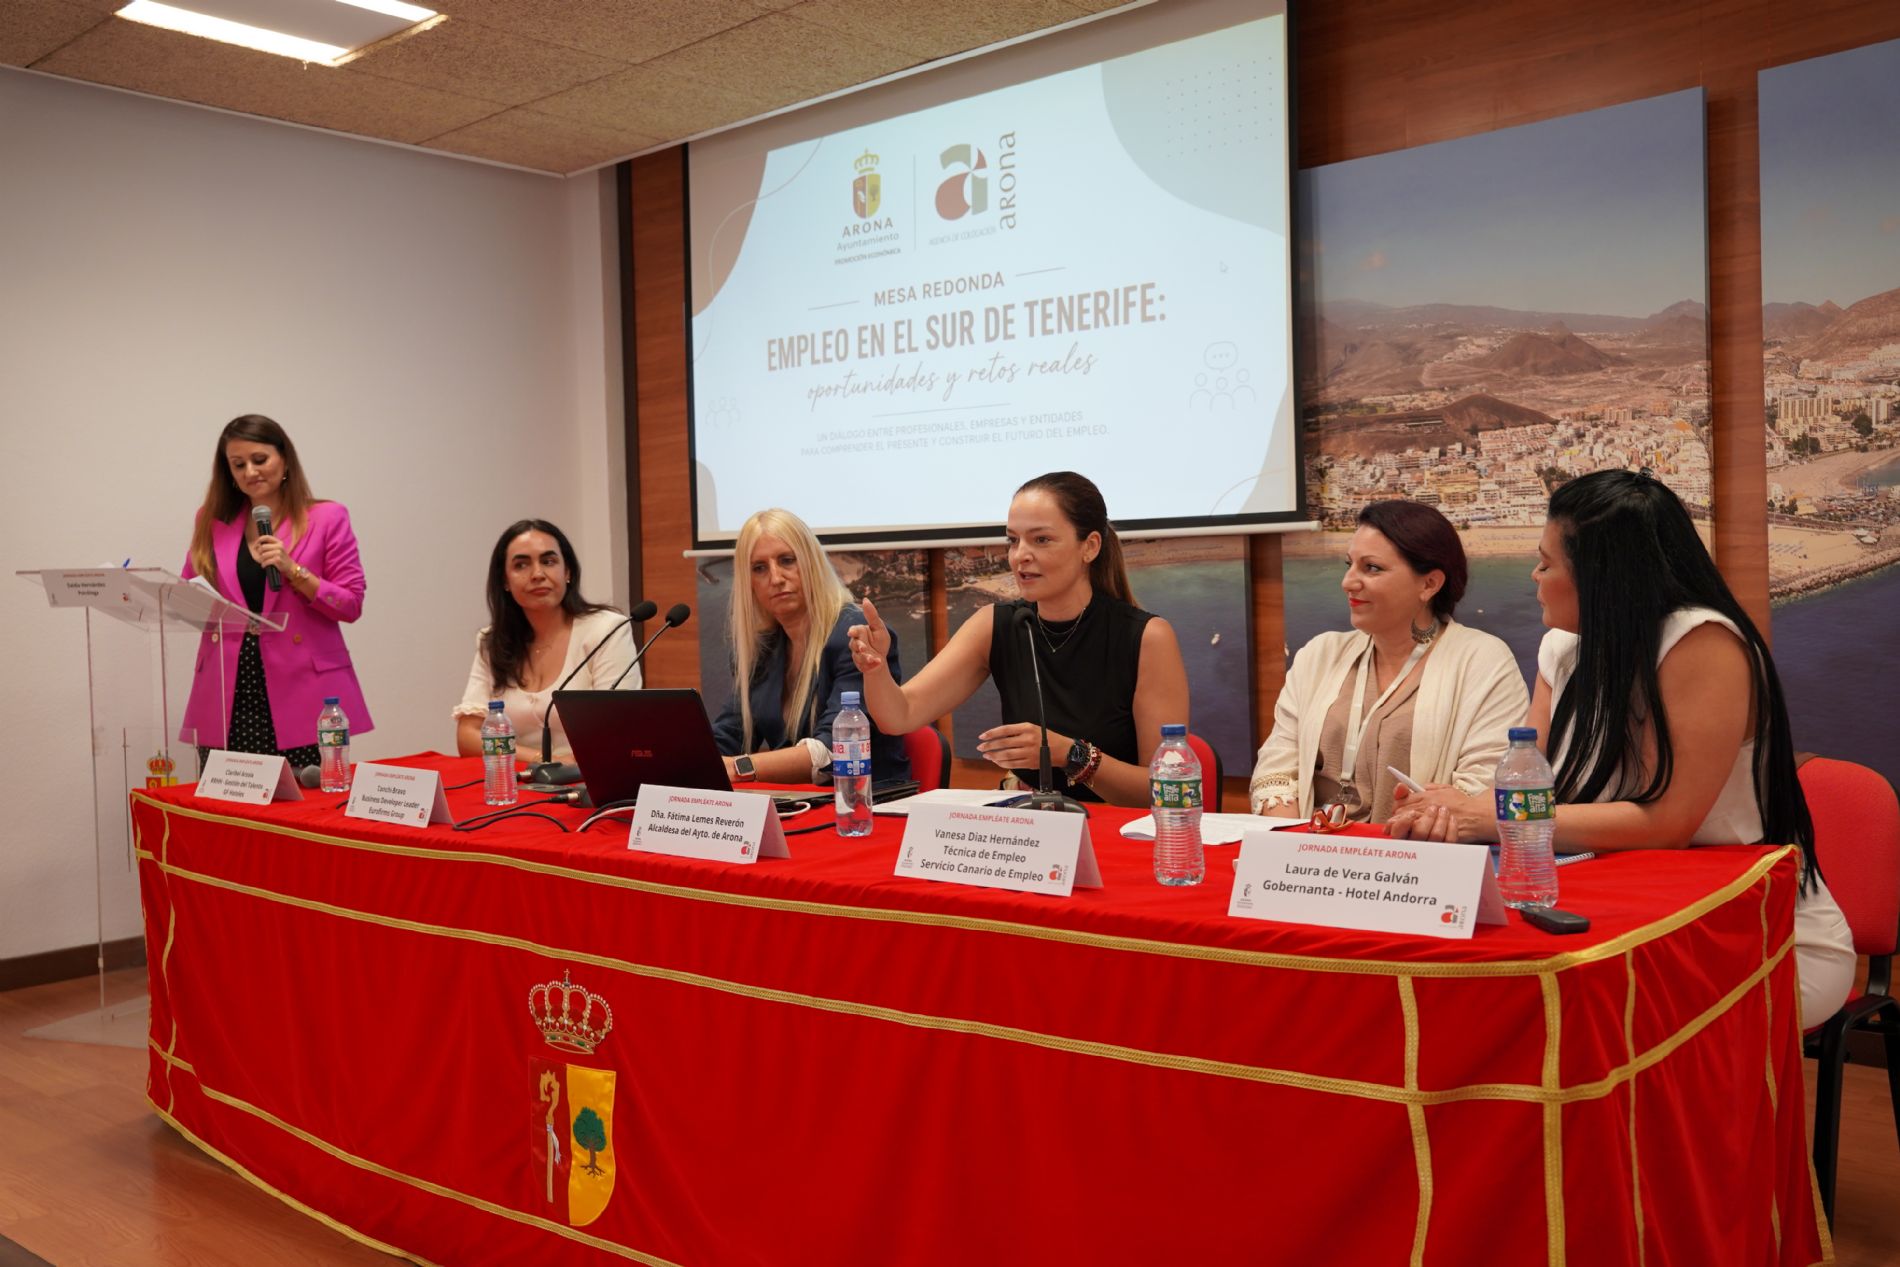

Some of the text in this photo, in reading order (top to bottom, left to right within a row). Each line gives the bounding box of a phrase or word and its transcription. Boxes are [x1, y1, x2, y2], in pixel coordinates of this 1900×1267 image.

[842, 217, 894, 238] ARONA
[836, 232, 900, 252] Ayuntamiento
[874, 271, 1005, 307] MESA REDONDA
[767, 282, 1166, 372] EMPLEO EN EL SUR DE TENERIFE:
[807, 341, 1098, 412] oportunidades y retos reales
[867, 426, 894, 437] ENTRE
[970, 416, 1018, 429] EMPRESAS
[1021, 415, 1027, 425] Y
[1030, 410, 1083, 425] ENTIDADES
[876, 441, 884, 451] EL
[887, 437, 928, 450] PRESENTE
[932, 437, 938, 446] Y
[939, 433, 991, 446] CONSTRUIR
[992, 432, 1002, 442] EL
[1005, 429, 1044, 441] FUTURO
[1046, 427, 1063, 439] DEL
[381, 797, 403, 806] Developer
[651, 810, 744, 828] Dña. Fátima Lemes Reverón
[949, 812, 978, 821] JORNADA
[1011, 816, 1034, 825] ARONA
[648, 823, 743, 842] Alcaldesa del Ayto. de Arona
[935, 829, 966, 840] Vanesa
[989, 834, 1040, 848] Hernández
[943, 845, 1026, 863] Técnica de Empleo
[1298, 843, 1417, 860] JORNADA EMPLÉATE ARONA
[920, 859, 955, 871] Servicio
[957, 863, 993, 876] Canario
[994, 867, 1006, 878] de
[1008, 868, 1043, 882] Empleo
[1285, 863, 1419, 885] Laura de Vera Galván
[1262, 880, 1335, 897] Gobernanta
[1345, 887, 1380, 900] Hotel
[1383, 891, 1437, 906] Andorra
